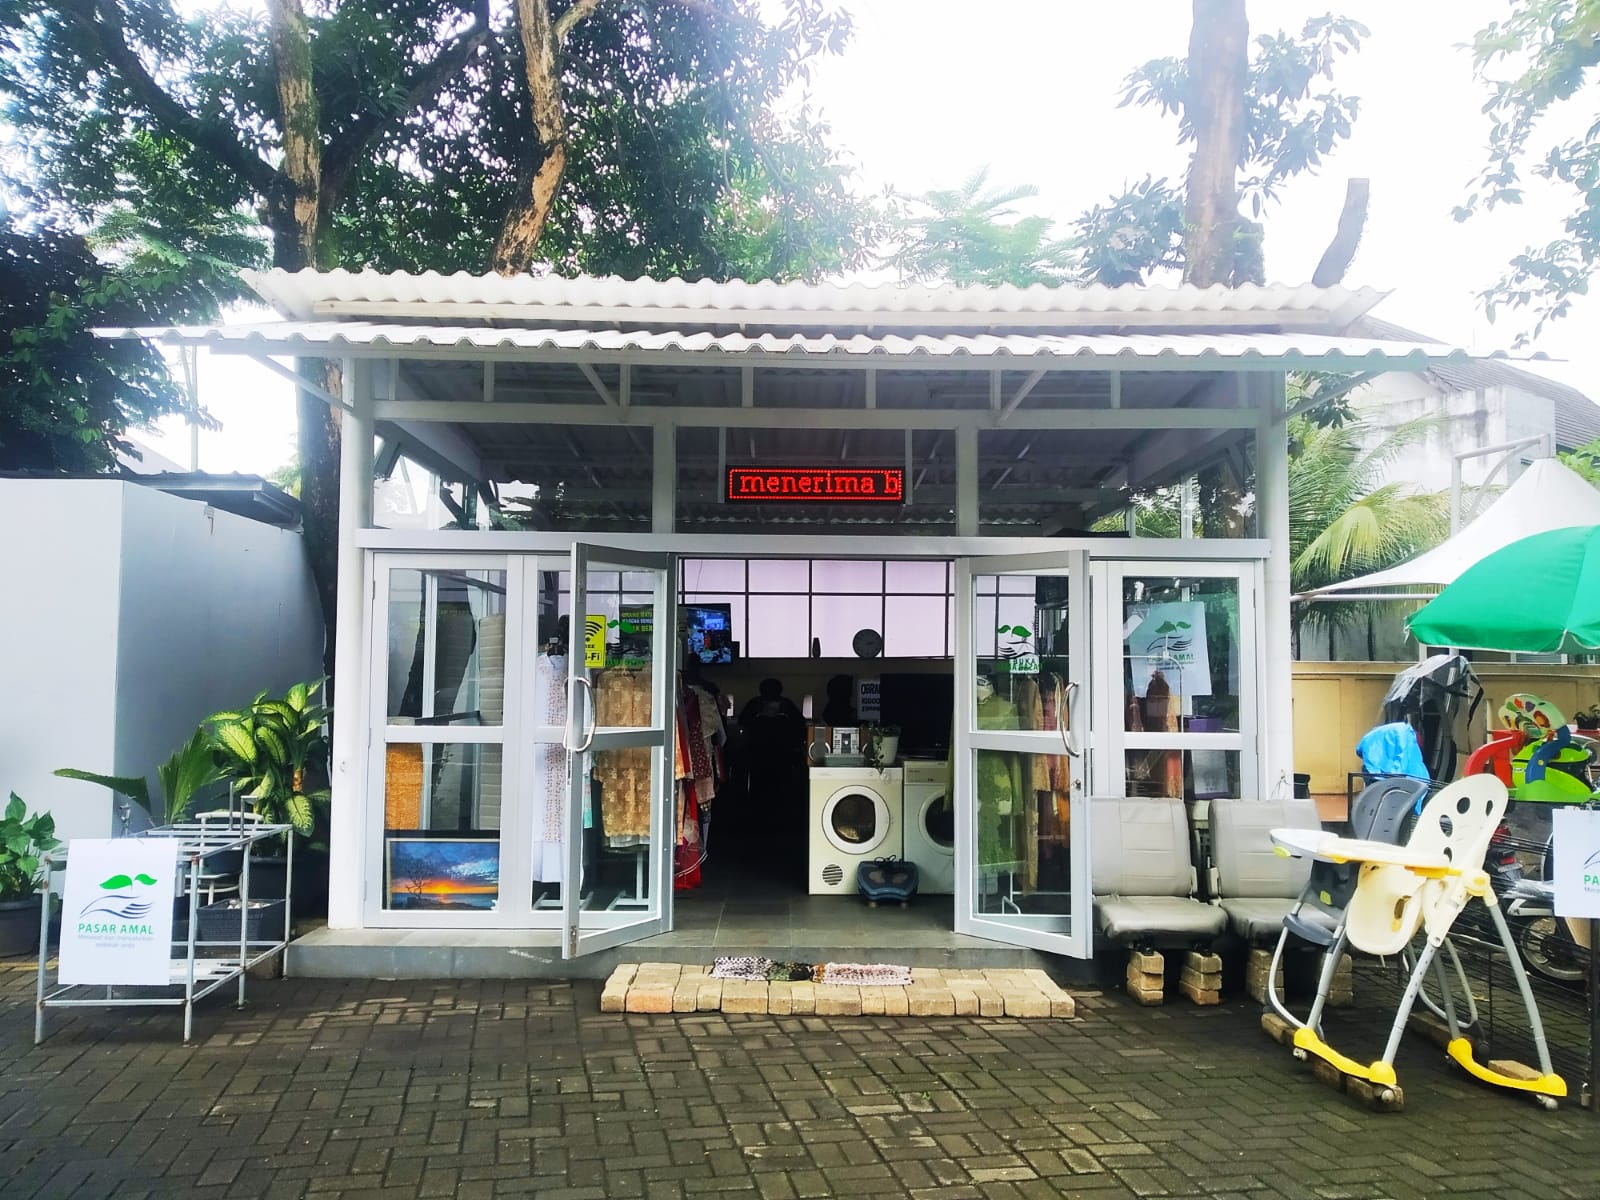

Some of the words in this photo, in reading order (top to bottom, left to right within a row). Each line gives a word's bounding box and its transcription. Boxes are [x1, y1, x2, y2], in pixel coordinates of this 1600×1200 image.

[739, 471, 875, 494] menerima
[78, 923, 117, 935] PASAR
[120, 924, 154, 936] AMAL
